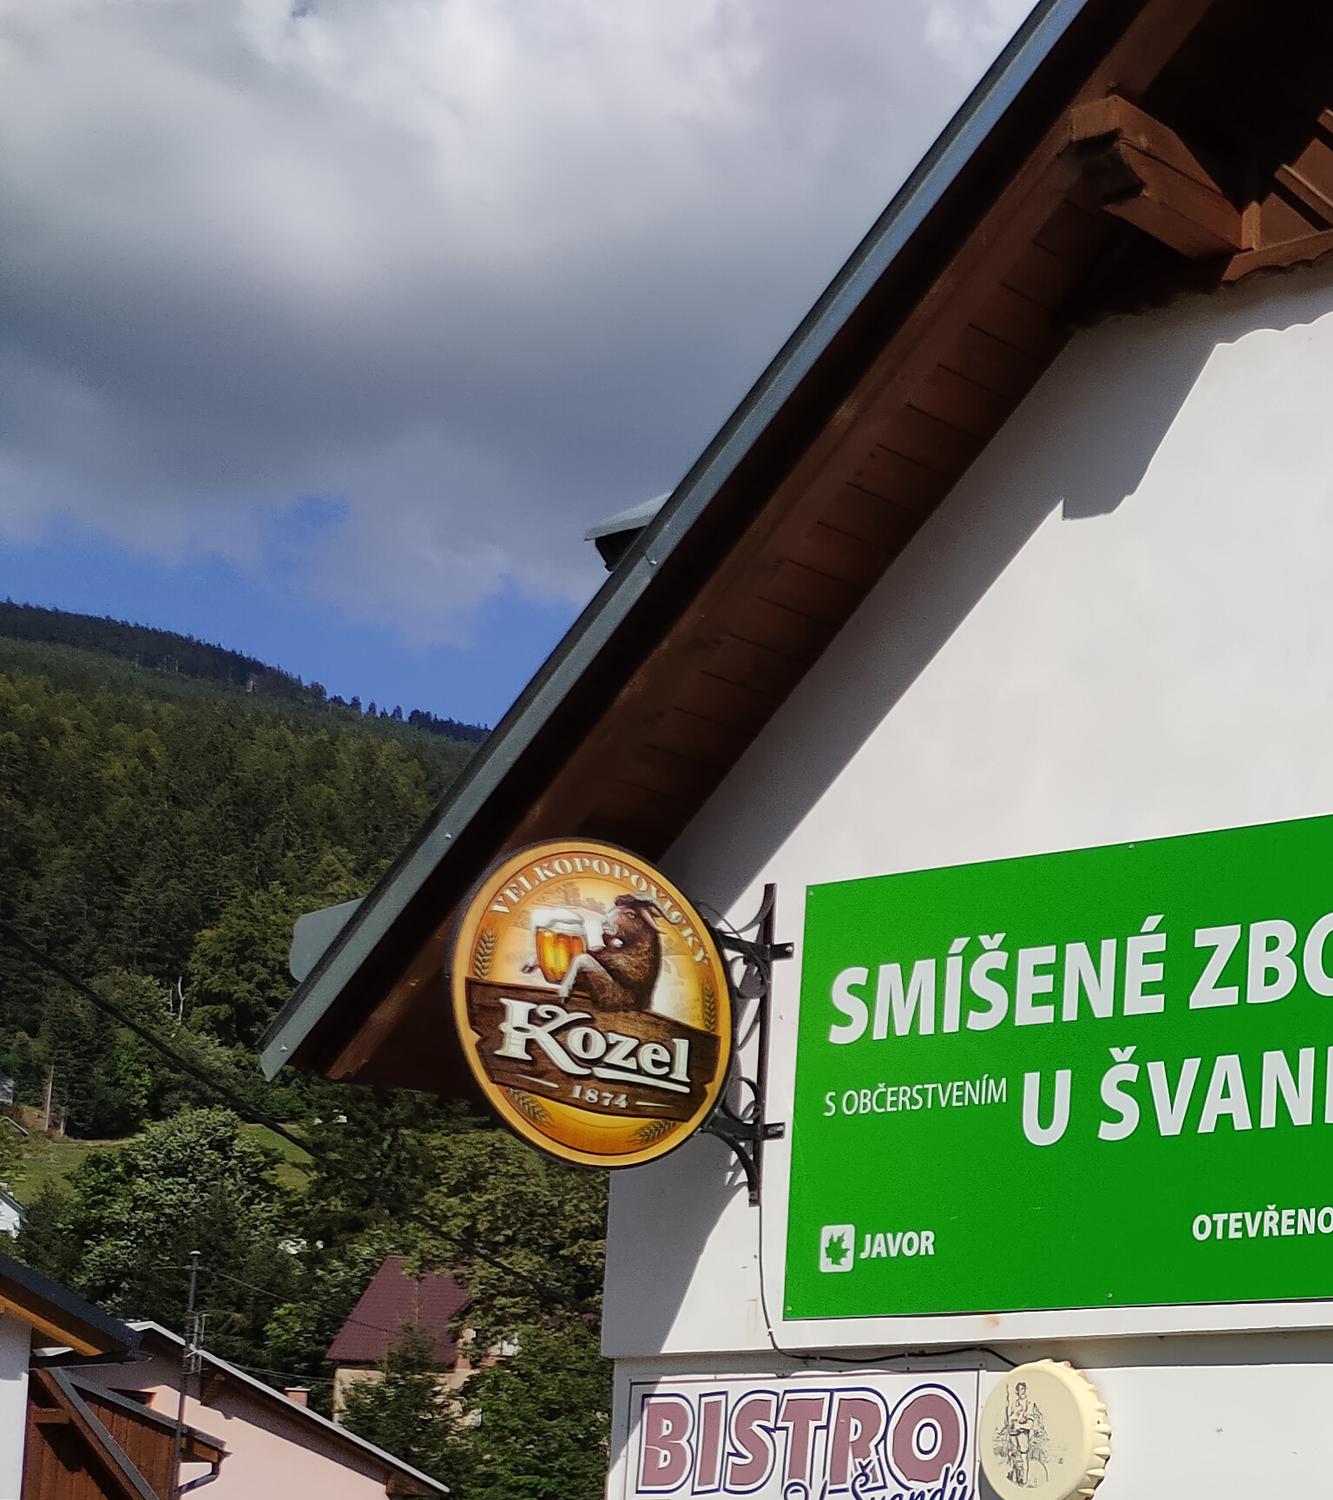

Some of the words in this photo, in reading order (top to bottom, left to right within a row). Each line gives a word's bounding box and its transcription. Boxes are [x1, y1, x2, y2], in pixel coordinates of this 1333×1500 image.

[828, 914, 1167, 1045] SMÍŠENÉ
[494, 998, 692, 1084] Kozel
[571, 1085, 629, 1110] 1874
[823, 1092, 838, 1118] S
[841, 1073, 1008, 1117] OBČERSTVENÍM
[1022, 1069, 1072, 1146] U
[859, 1230, 935, 1260] JAVOR
[636, 1383, 968, 1496] BISTRO
